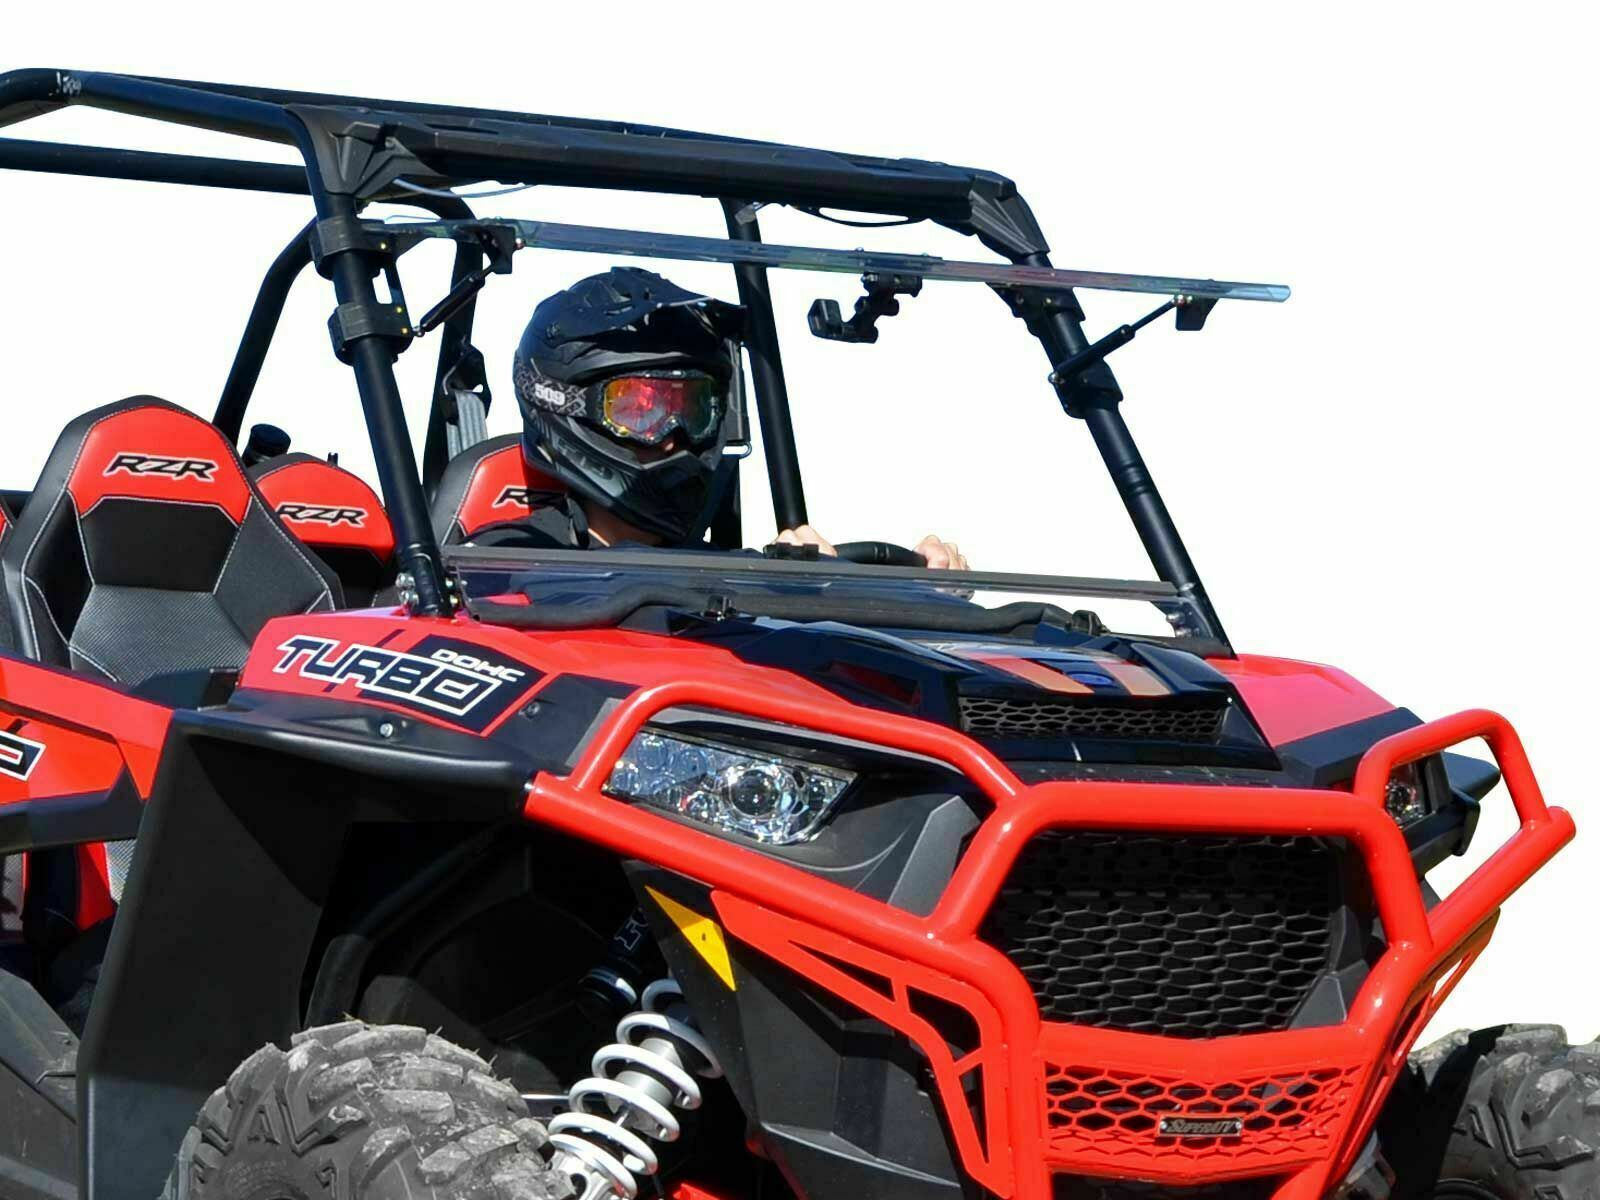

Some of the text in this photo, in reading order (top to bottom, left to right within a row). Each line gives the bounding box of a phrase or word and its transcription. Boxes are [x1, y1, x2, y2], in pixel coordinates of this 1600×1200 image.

[535, 383, 566, 406] 509
[102, 451, 219, 482] RZR
[491, 484, 567, 509] RZ
[275, 501, 368, 528] RZR
[272, 634, 502, 716] TURBO
[429, 648, 526, 683] DOHC
